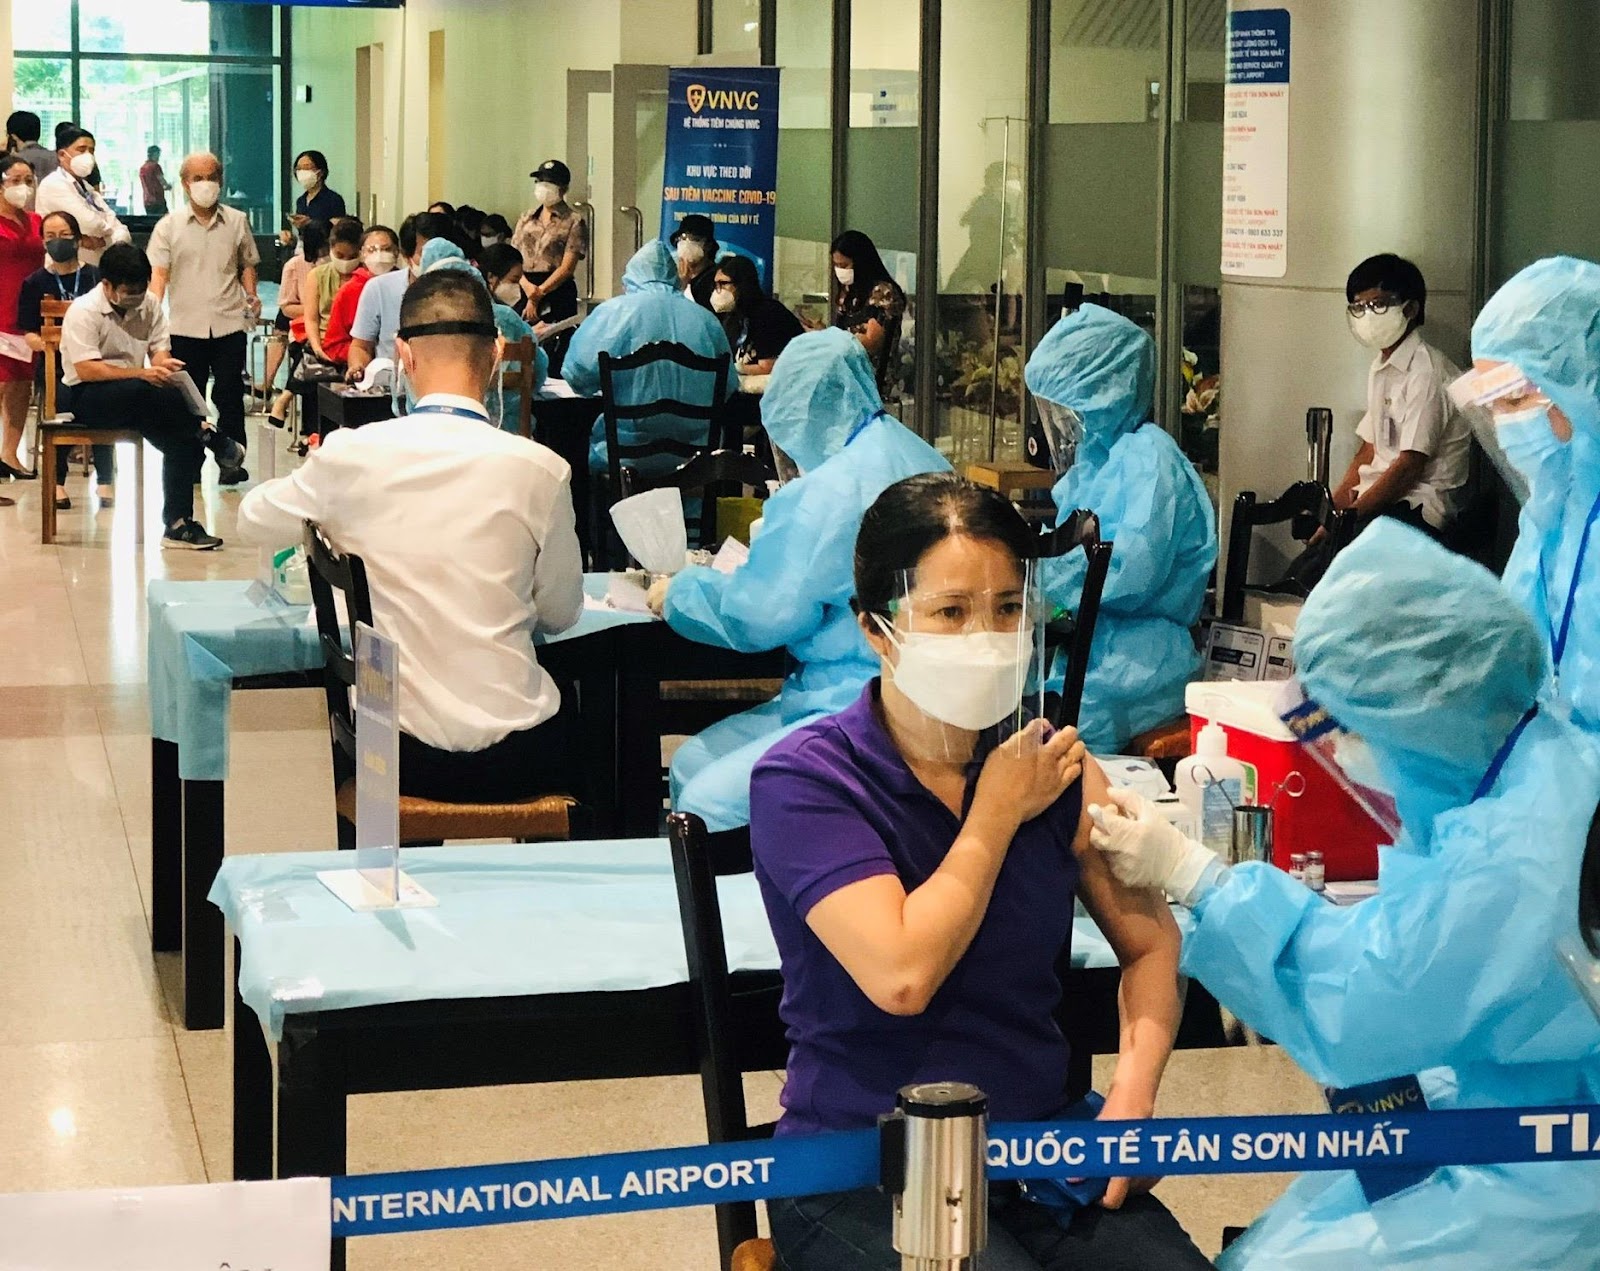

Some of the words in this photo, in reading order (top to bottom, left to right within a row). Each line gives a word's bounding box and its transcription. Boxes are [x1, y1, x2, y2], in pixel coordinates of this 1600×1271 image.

[1261, 61, 1283, 69] QUALITY
[707, 90, 759, 111] VNVC
[686, 165, 701, 177] KHU
[703, 165, 718, 179] VỰC
[719, 166, 737, 178] THEO
[664, 187, 680, 201] SAU
[681, 185, 700, 201] TIÊM
[702, 188, 737, 203] VACCINE
[739, 190, 776, 206] COVID-19
[1518, 1112, 1600, 1154] TI
[986, 1129, 1086, 1169] QUỐC
[1097, 1128, 1142, 1164] TẾ
[1151, 1128, 1220, 1163] TÂN
[1231, 1131, 1306, 1161] SƠN
[1317, 1121, 1410, 1158] NHẤT
[333, 1175, 612, 1223] NTERNATIONAL
[620, 1157, 775, 1199] AIRPORT
